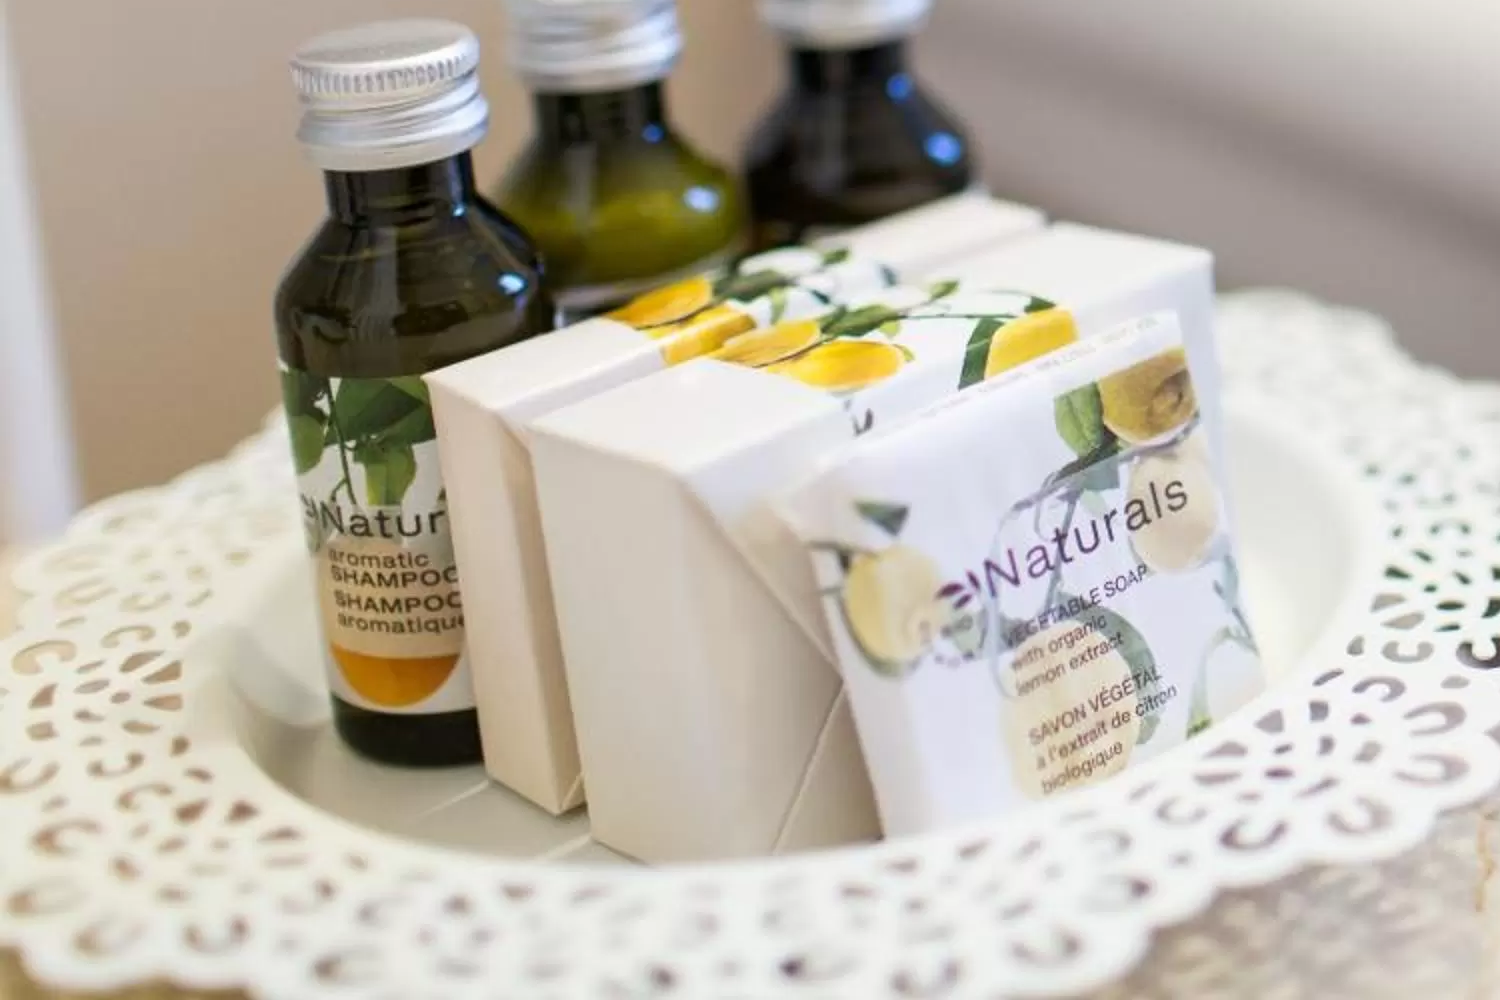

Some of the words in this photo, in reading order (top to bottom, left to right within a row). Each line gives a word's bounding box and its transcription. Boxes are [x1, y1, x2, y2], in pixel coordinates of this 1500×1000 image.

[319, 500, 446, 538] Natur
[983, 480, 1189, 598] Naturals
[329, 549, 430, 569] aromatic
[1003, 587, 1102, 647] VEGETABLE
[1103, 563, 1149, 598] SOAP
[1047, 615, 1108, 653] organic
[1069, 631, 1125, 670] extract
[1028, 703, 1088, 746] SAVON
[1111, 709, 1132, 730] de
[1135, 684, 1178, 718] citron
[1040, 741, 1124, 795] biologique
